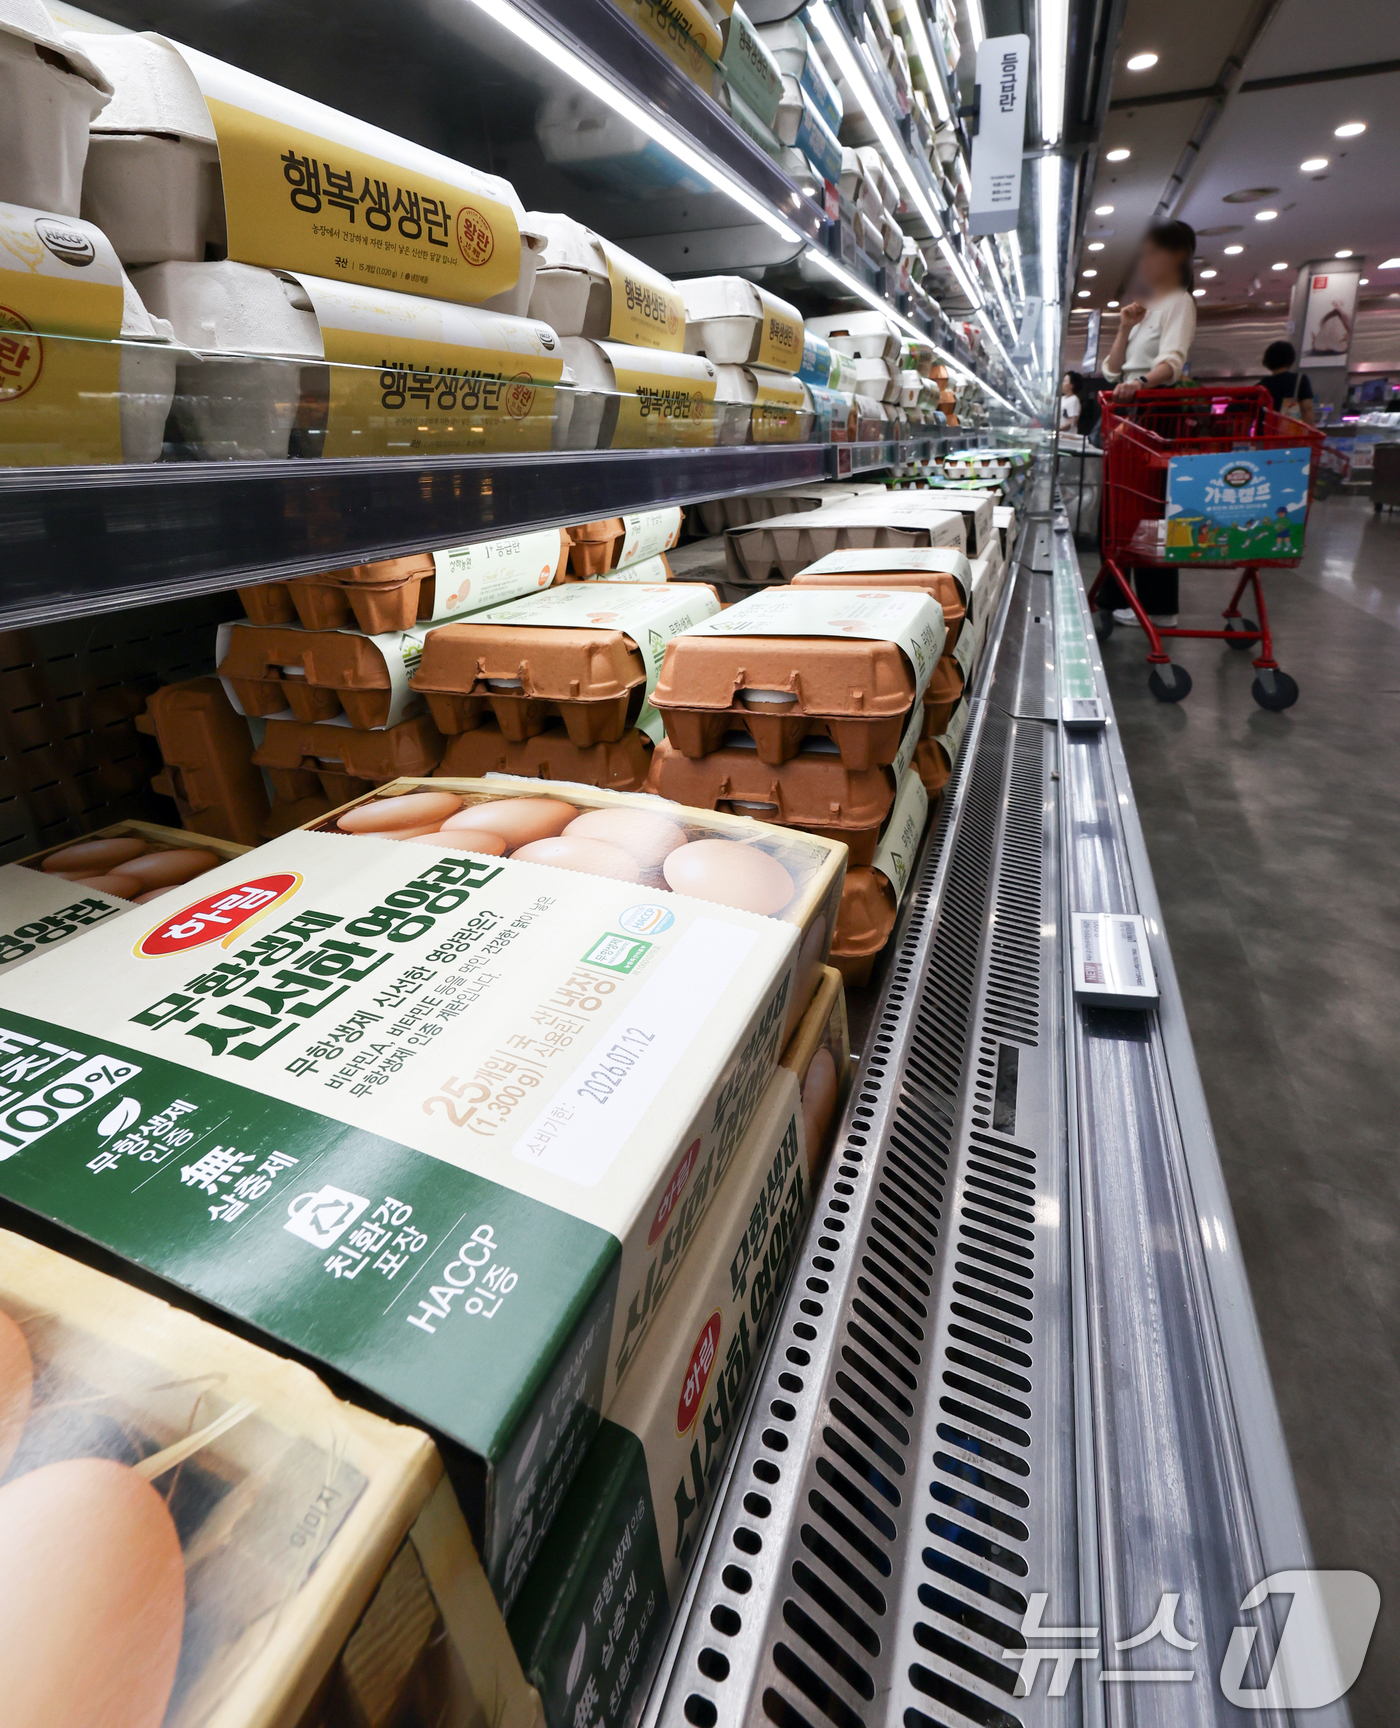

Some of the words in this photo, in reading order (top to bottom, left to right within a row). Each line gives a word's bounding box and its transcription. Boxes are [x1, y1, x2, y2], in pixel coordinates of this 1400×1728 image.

[1000, 52, 1018, 113] 등급란
[280, 150, 451, 247] 행복생생란
[464, 218, 490, 253] 왕란
[44, 230, 84, 245] HACCP
[312, 223, 340, 239] 농장에서
[342, 231, 368, 246] 건강하게
[370, 238, 383, 250] 자란
[411, 248, 429, 260] 신선한
[334, 256, 348, 269] 국산
[625, 277, 666, 325] 행복생생란
[769, 318, 794, 347] 행복생생란
[375, 360, 507, 411] 행복생생란
[636, 385, 692, 419] 행복생생란
[449, 557, 472, 573] 상하농원
[496, 538, 521, 557] 등급란
[162, 885, 278, 941] 하림
[632, 907, 656, 930] HACCP
[129, 909, 345, 1031] 무항생제
[185, 939, 395, 1061] 신선한
[344, 857, 506, 943] 영양란
[285, 1009, 384, 1077] 무항생제
[372, 965, 438, 1008] 신선한
[425, 910, 504, 964] 영양란은?
[324, 1040, 396, 1090] 비타민A,
[386, 994, 444, 1037] 비타민E
[433, 975, 468, 996] 등을
[458, 955, 490, 974] 먹인
[481, 929, 519, 955] 건강한
[349, 1046, 417, 1098] 무항생제
[407, 1023, 443, 1047] 인증
[436, 972, 503, 1022] 계란입니다.
[534, 1016, 585, 1058] 식용란
[422, 1056, 519, 1129] 25개입
[549, 972, 617, 1012] 냉장
[576, 1027, 656, 1105] 2026.07.12
[711, 968, 791, 1134] 무항생제
[0, 1065, 132, 1148] 100%
[86, 1099, 199, 1175] 무항생제
[139, 1127, 194, 1163] 인증
[179, 1144, 257, 1198] 無
[207, 1150, 300, 1225] 살충제
[658, 1150, 693, 1223] 하림
[730, 1113, 799, 1304] 무항생제
[323, 1197, 413, 1282] 친환경
[371, 1219, 430, 1281] 포장
[615, 1146, 715, 1386] 신선한
[405, 1223, 499, 1335] HACCP
[464, 1265, 520, 1320] 인증
[684, 1325, 715, 1407] 하림
[290, 1484, 342, 1549] 이미지
[593, 1523, 632, 1627] 무항생제
[630, 1495, 646, 1536] 인증
[602, 1569, 638, 1671] 살충제
[609, 1629, 640, 1718] 친환경
